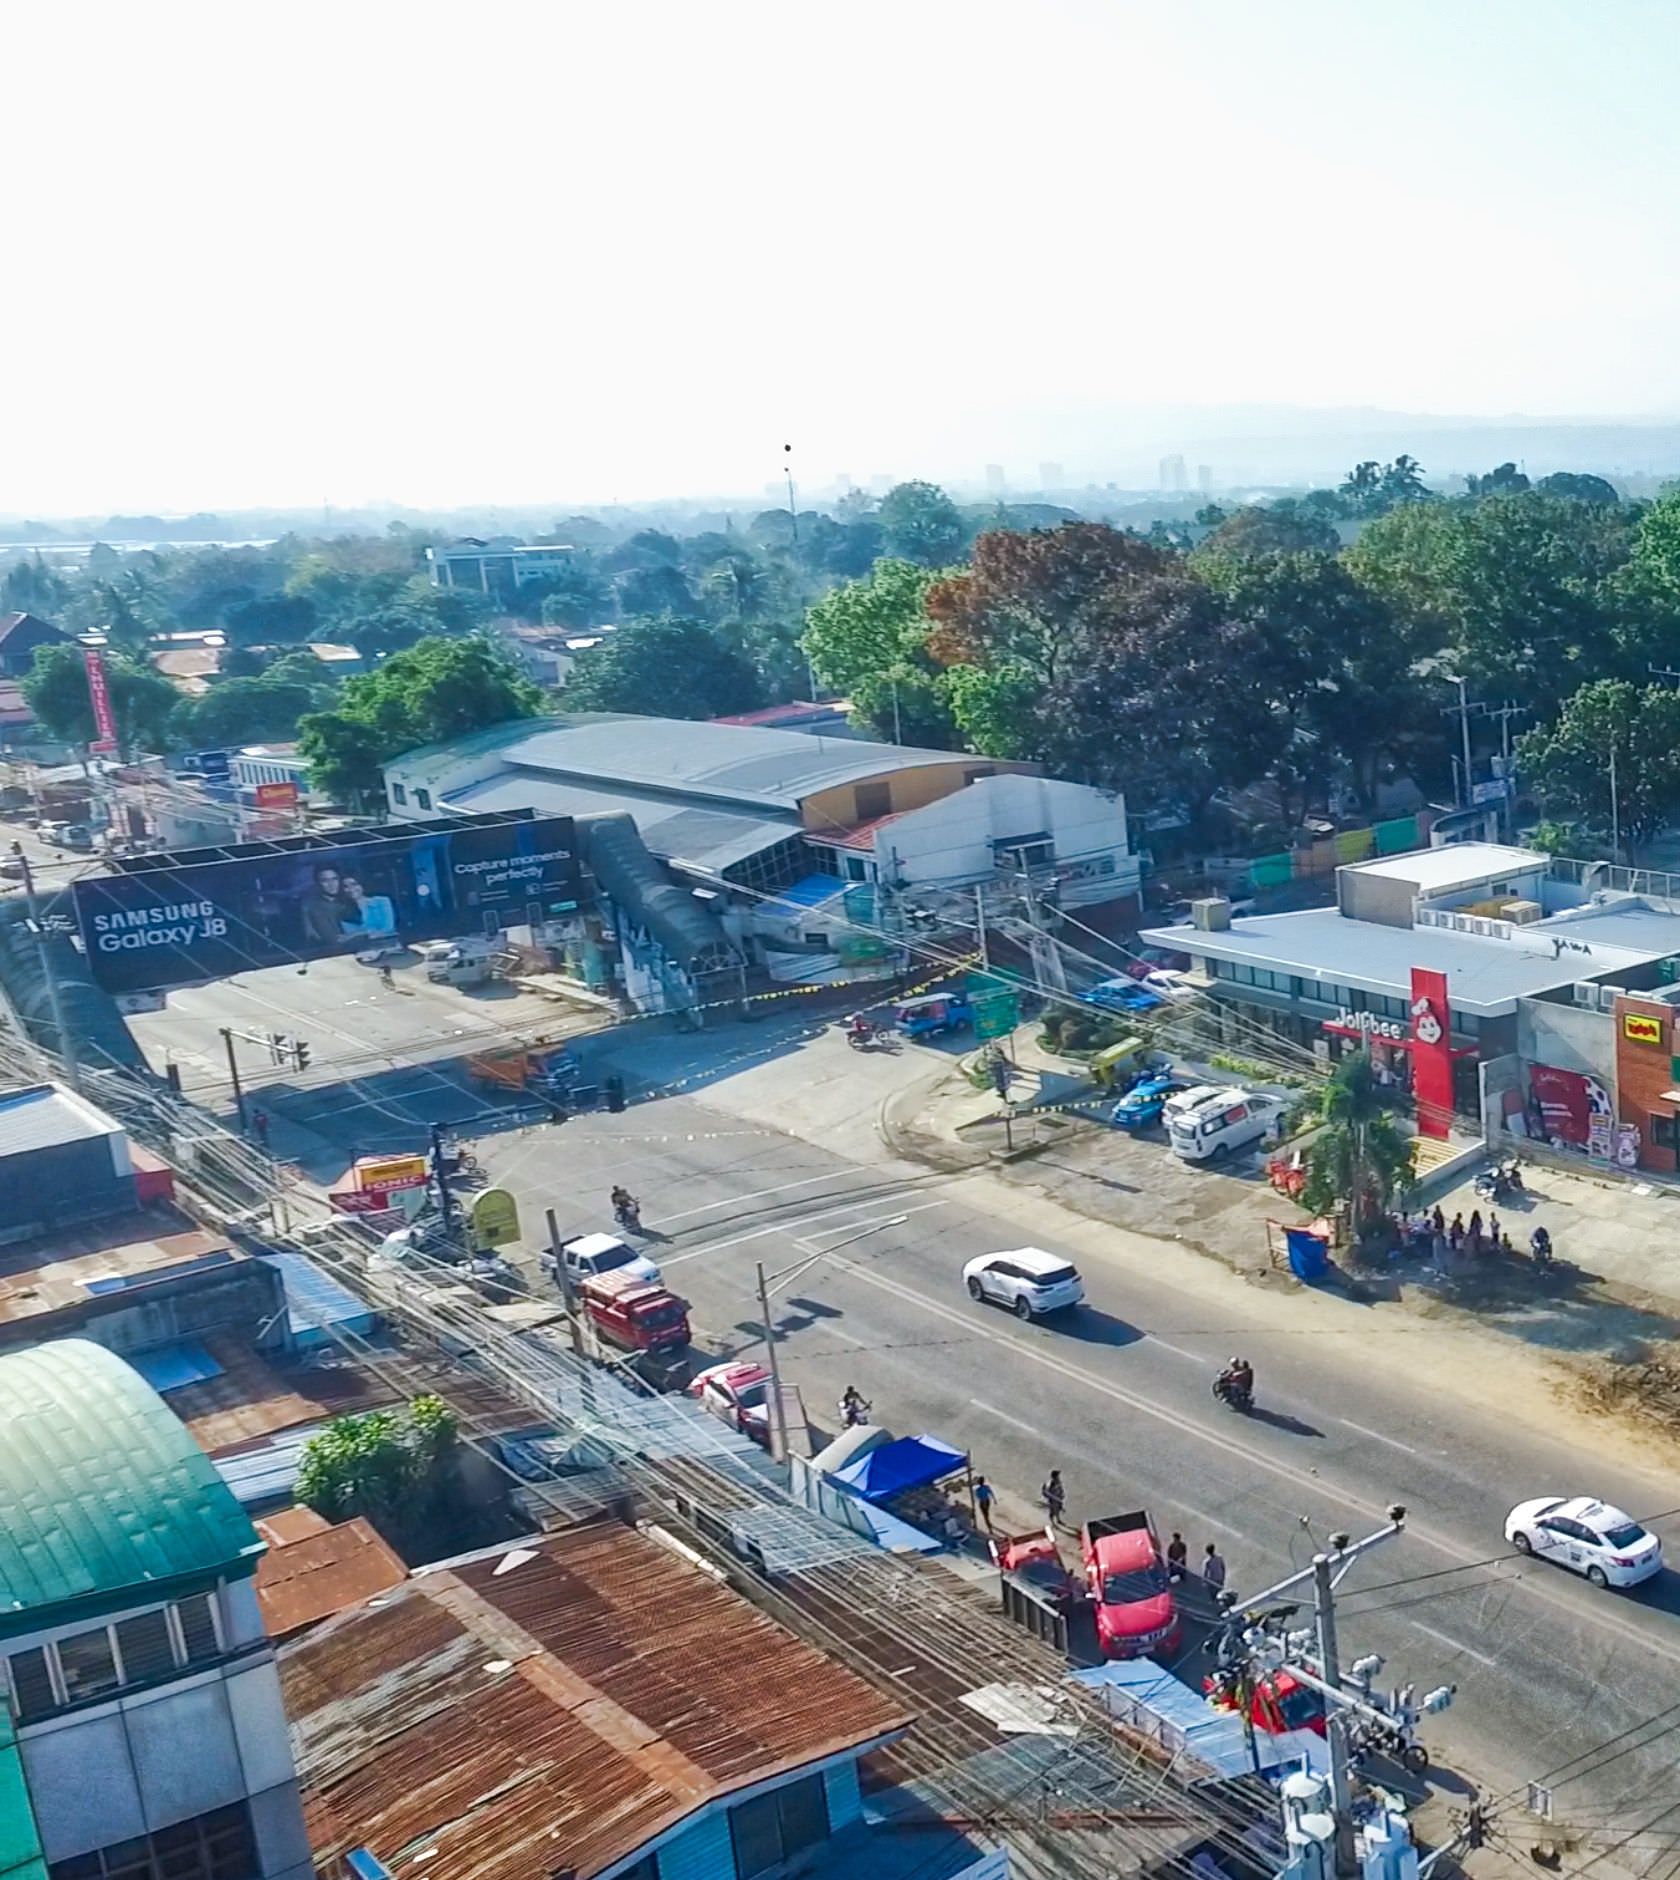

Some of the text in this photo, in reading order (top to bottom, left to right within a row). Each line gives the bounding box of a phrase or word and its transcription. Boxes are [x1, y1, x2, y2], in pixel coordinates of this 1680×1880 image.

[455, 850, 571, 875] Capture moments
[485, 867, 544, 886] perfectly
[94, 900, 214, 931] SAMSUNG
[99, 918, 226, 952] Galaxy J8
